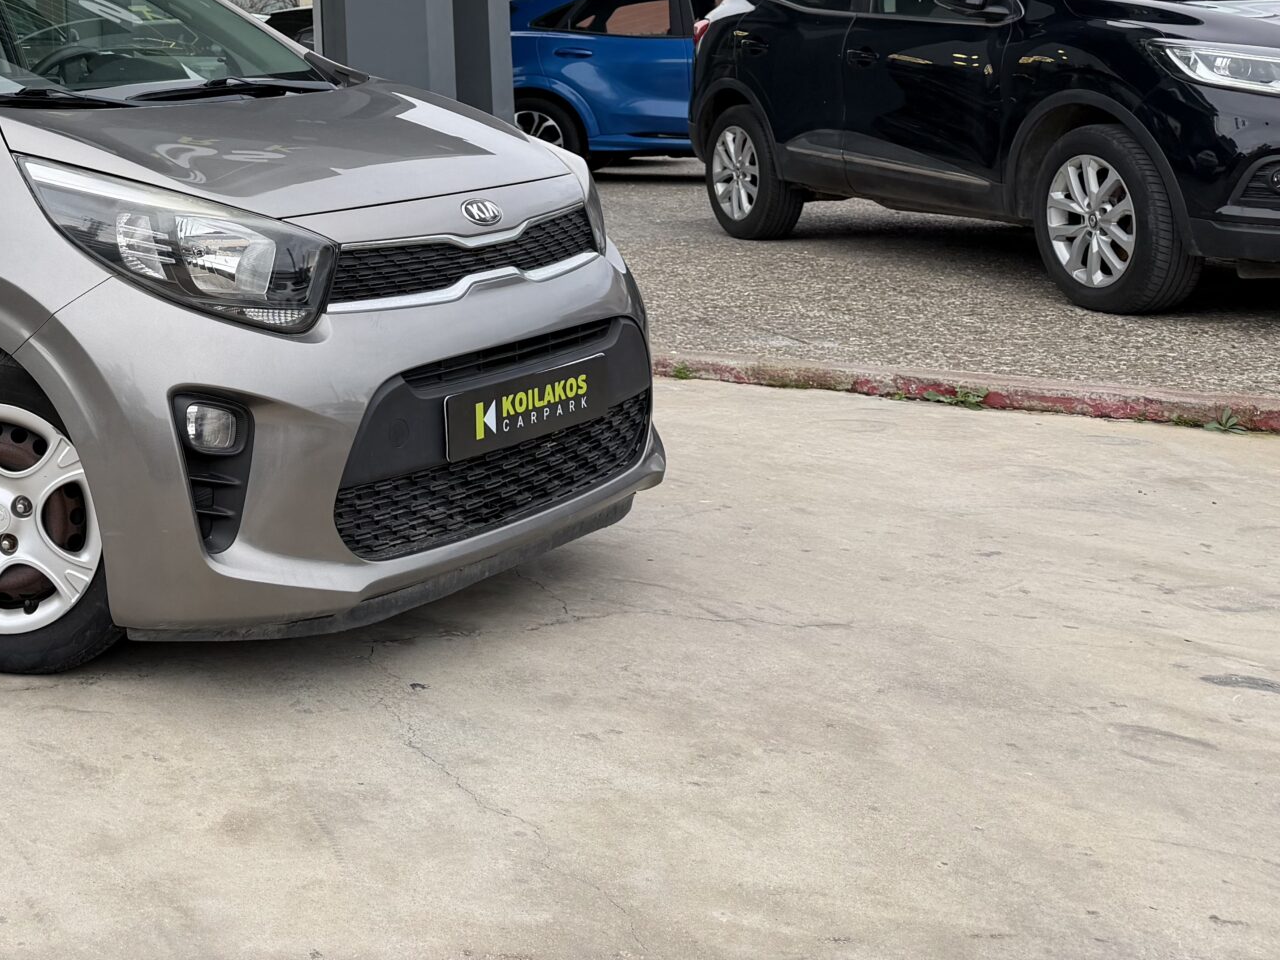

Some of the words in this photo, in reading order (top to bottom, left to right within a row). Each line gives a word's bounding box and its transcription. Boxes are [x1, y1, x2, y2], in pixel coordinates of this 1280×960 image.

[466, 201, 499, 219] KIA
[501, 374, 587, 418] KOILAKOS
[502, 396, 588, 432] CARPARK
